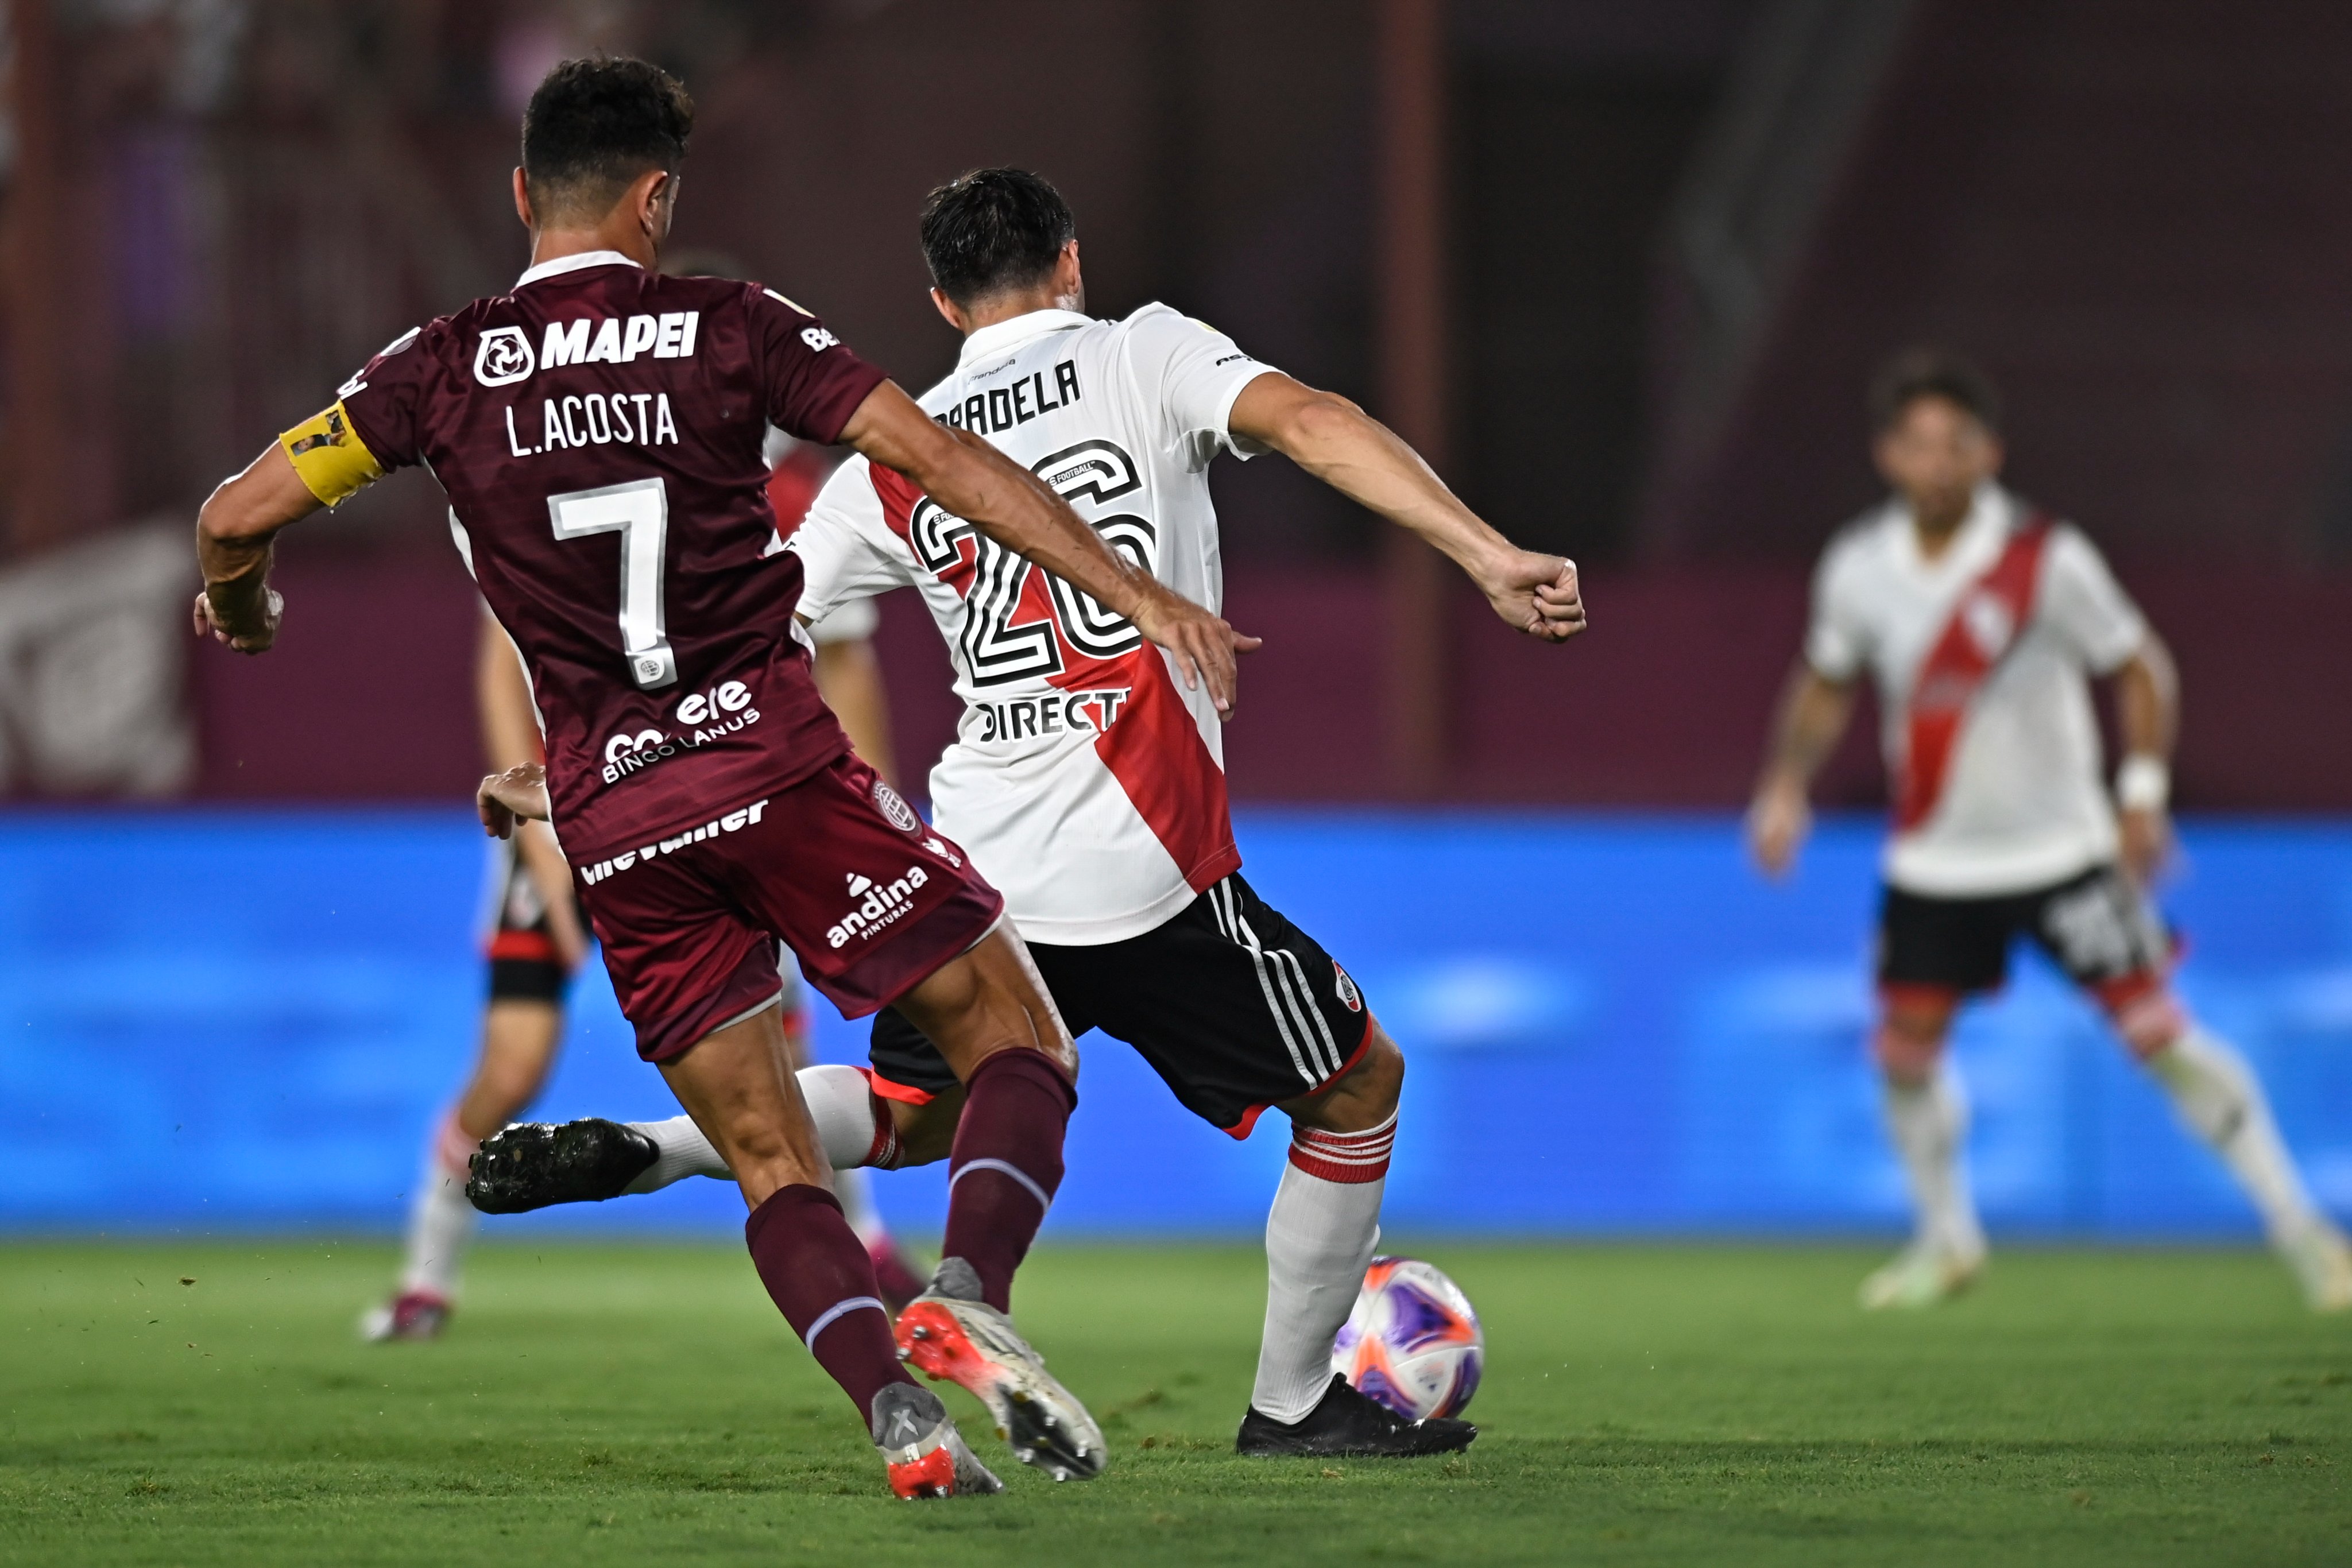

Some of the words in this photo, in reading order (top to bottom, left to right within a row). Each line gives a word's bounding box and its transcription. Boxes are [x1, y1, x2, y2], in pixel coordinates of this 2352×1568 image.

[540, 311, 699, 370] MAPEI
[506, 393, 678, 457] L.ACOSTA
[933, 359, 1080, 435] RADELA
[547, 477, 678, 691] 7
[910, 439, 1156, 688] 26
[602, 745, 675, 784] BINGO
[678, 708, 760, 748] LANUS
[605, 681, 752, 764] coere
[975, 688, 1131, 742] DIRECT
[826, 866, 929, 948] andina
[861, 900, 914, 940] PINTURAS
